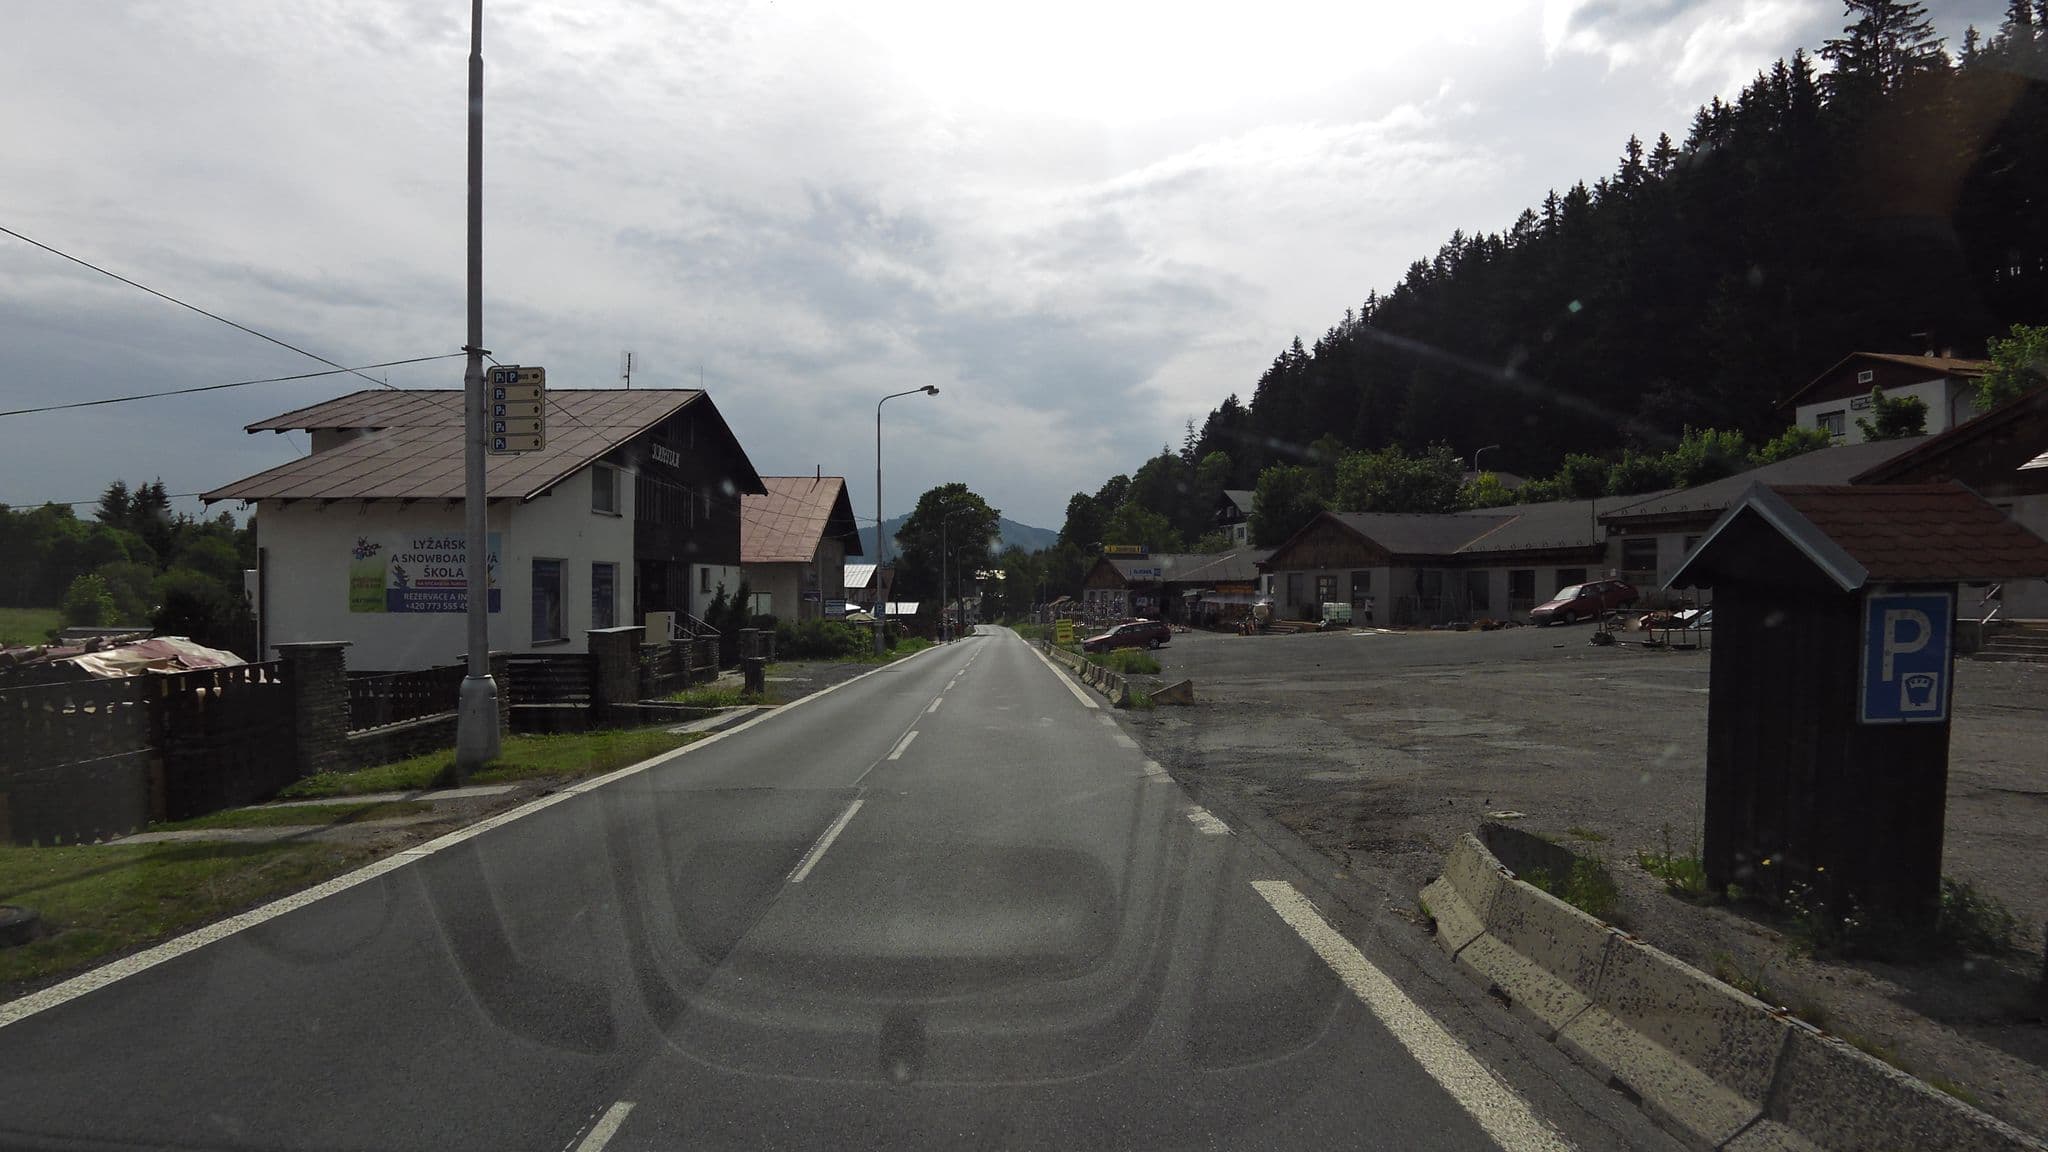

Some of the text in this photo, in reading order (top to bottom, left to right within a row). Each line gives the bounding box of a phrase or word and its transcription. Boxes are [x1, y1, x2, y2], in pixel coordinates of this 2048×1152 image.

[413, 537, 466, 550] LYŽAŘSK
[391, 553, 399, 563] A
[424, 565, 465, 578] ŠKOLA
[403, 592, 449, 601] REZERVACE
[450, 592, 456, 601] A
[405, 602, 425, 610] +420
[426, 602, 441, 610] 773
[1882, 609, 1931, 681] P
